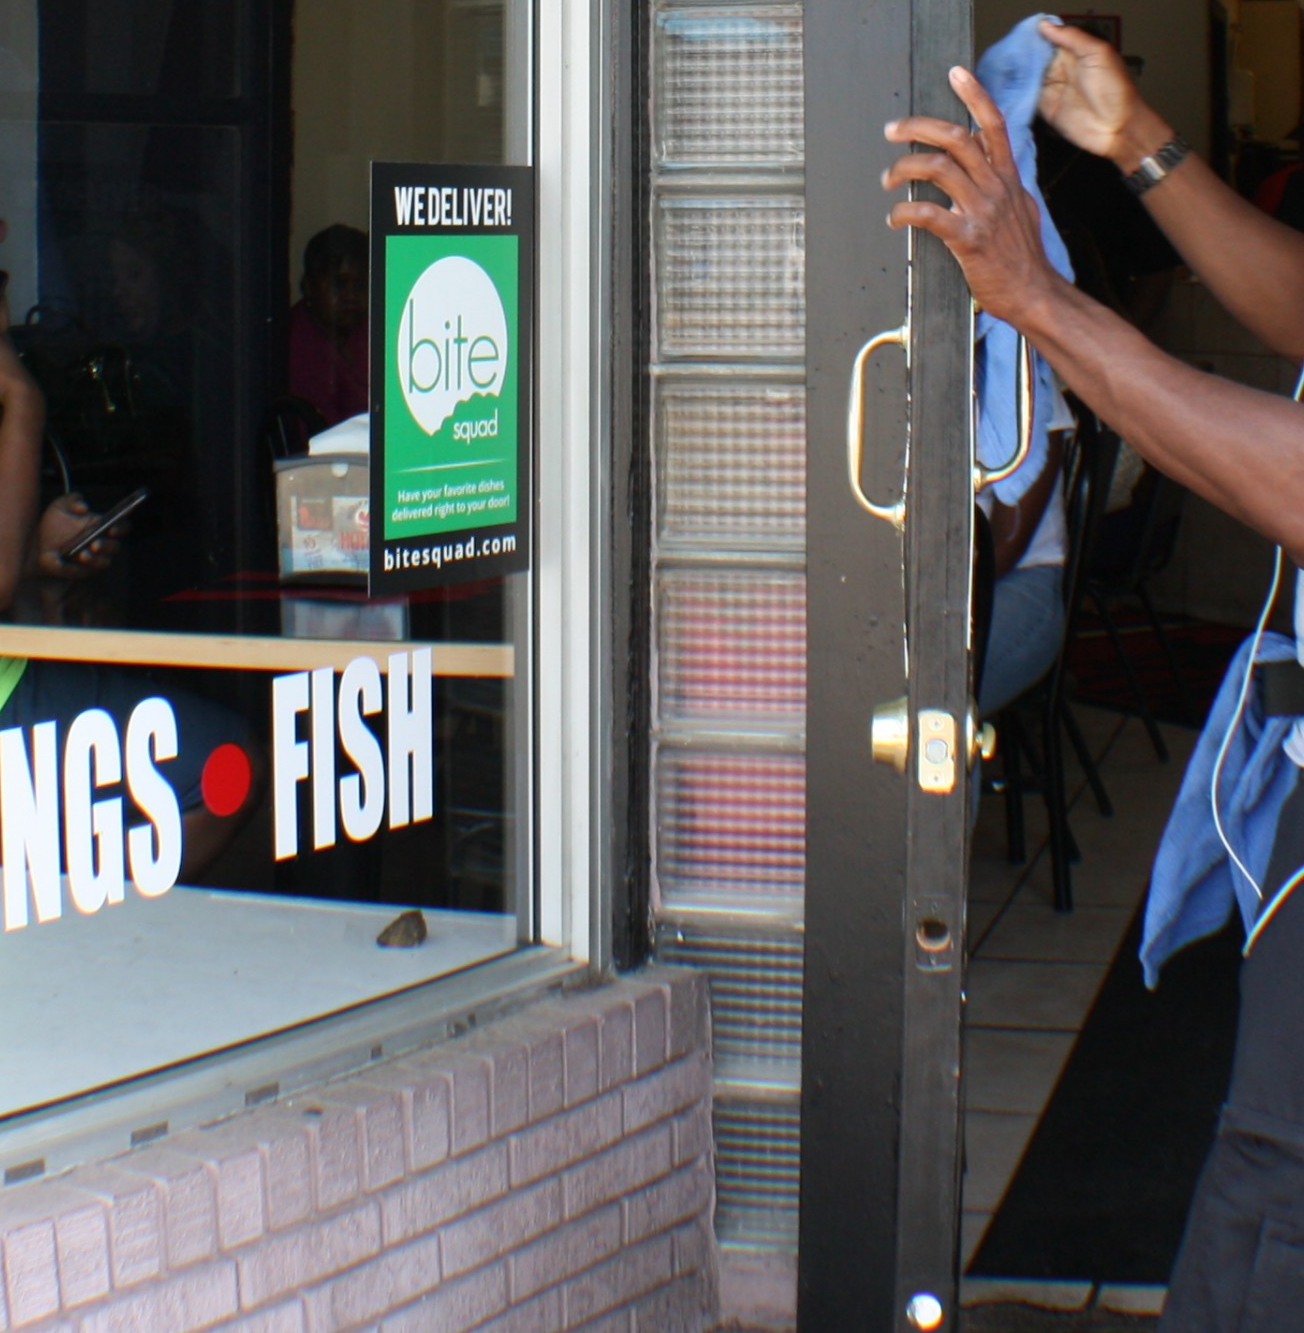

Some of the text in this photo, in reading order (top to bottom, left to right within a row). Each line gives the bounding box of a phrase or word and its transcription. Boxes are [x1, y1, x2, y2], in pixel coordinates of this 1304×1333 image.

[394, 187, 513, 227] WE DELIVER!
[409, 298, 500, 394] bite
[452, 408, 499, 445] squad
[391, 503, 433, 522] delivered
[434, 500, 456, 519] right
[456, 500, 466, 513] to
[466, 498, 487, 516] your
[397, 478, 505, 505] Have your favorite dishes
[383, 534, 517, 572] bitesquad.com
[272, 647, 435, 862] FISH
